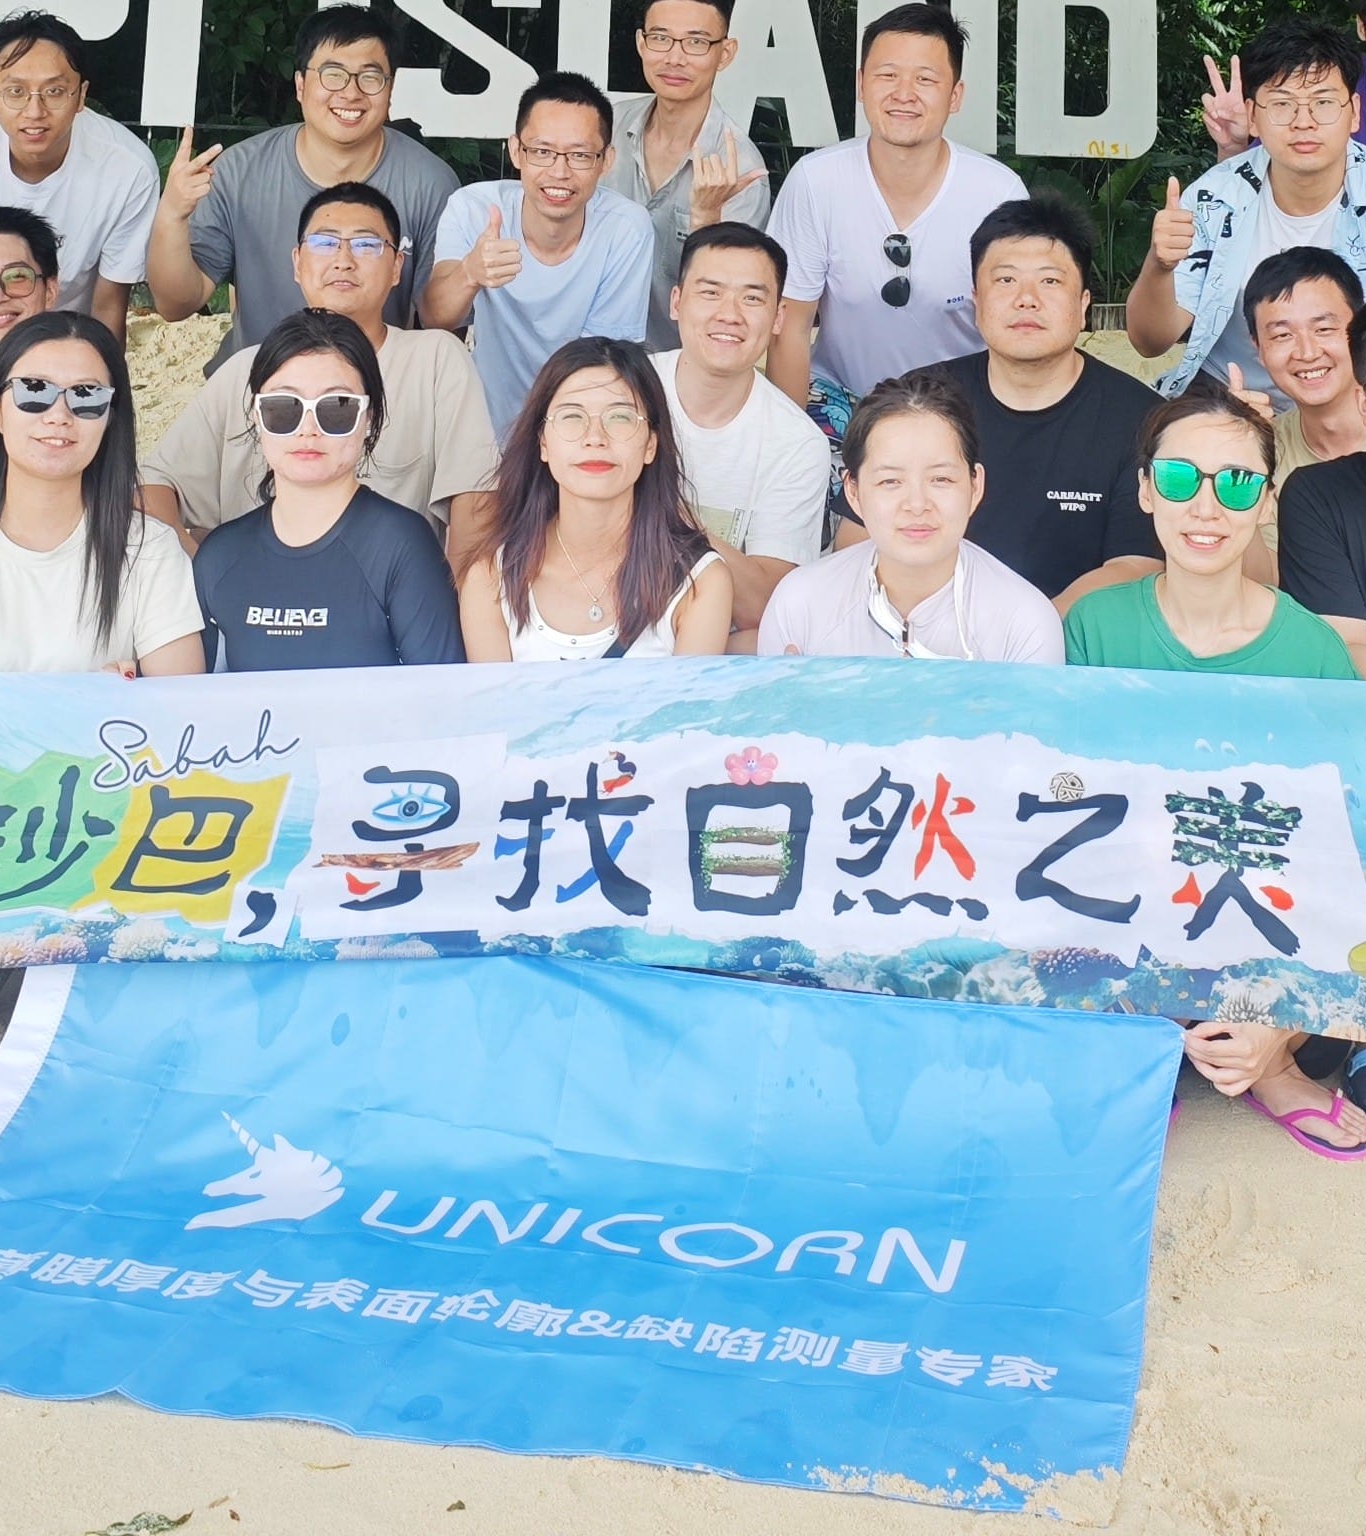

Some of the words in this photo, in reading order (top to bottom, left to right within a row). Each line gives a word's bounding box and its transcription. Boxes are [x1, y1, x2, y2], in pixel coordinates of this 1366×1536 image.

[1046, 490, 1103, 502] CARHARTT
[90, 709, 300, 790] Sabah
[361, 1189, 967, 1294] UNICORN
